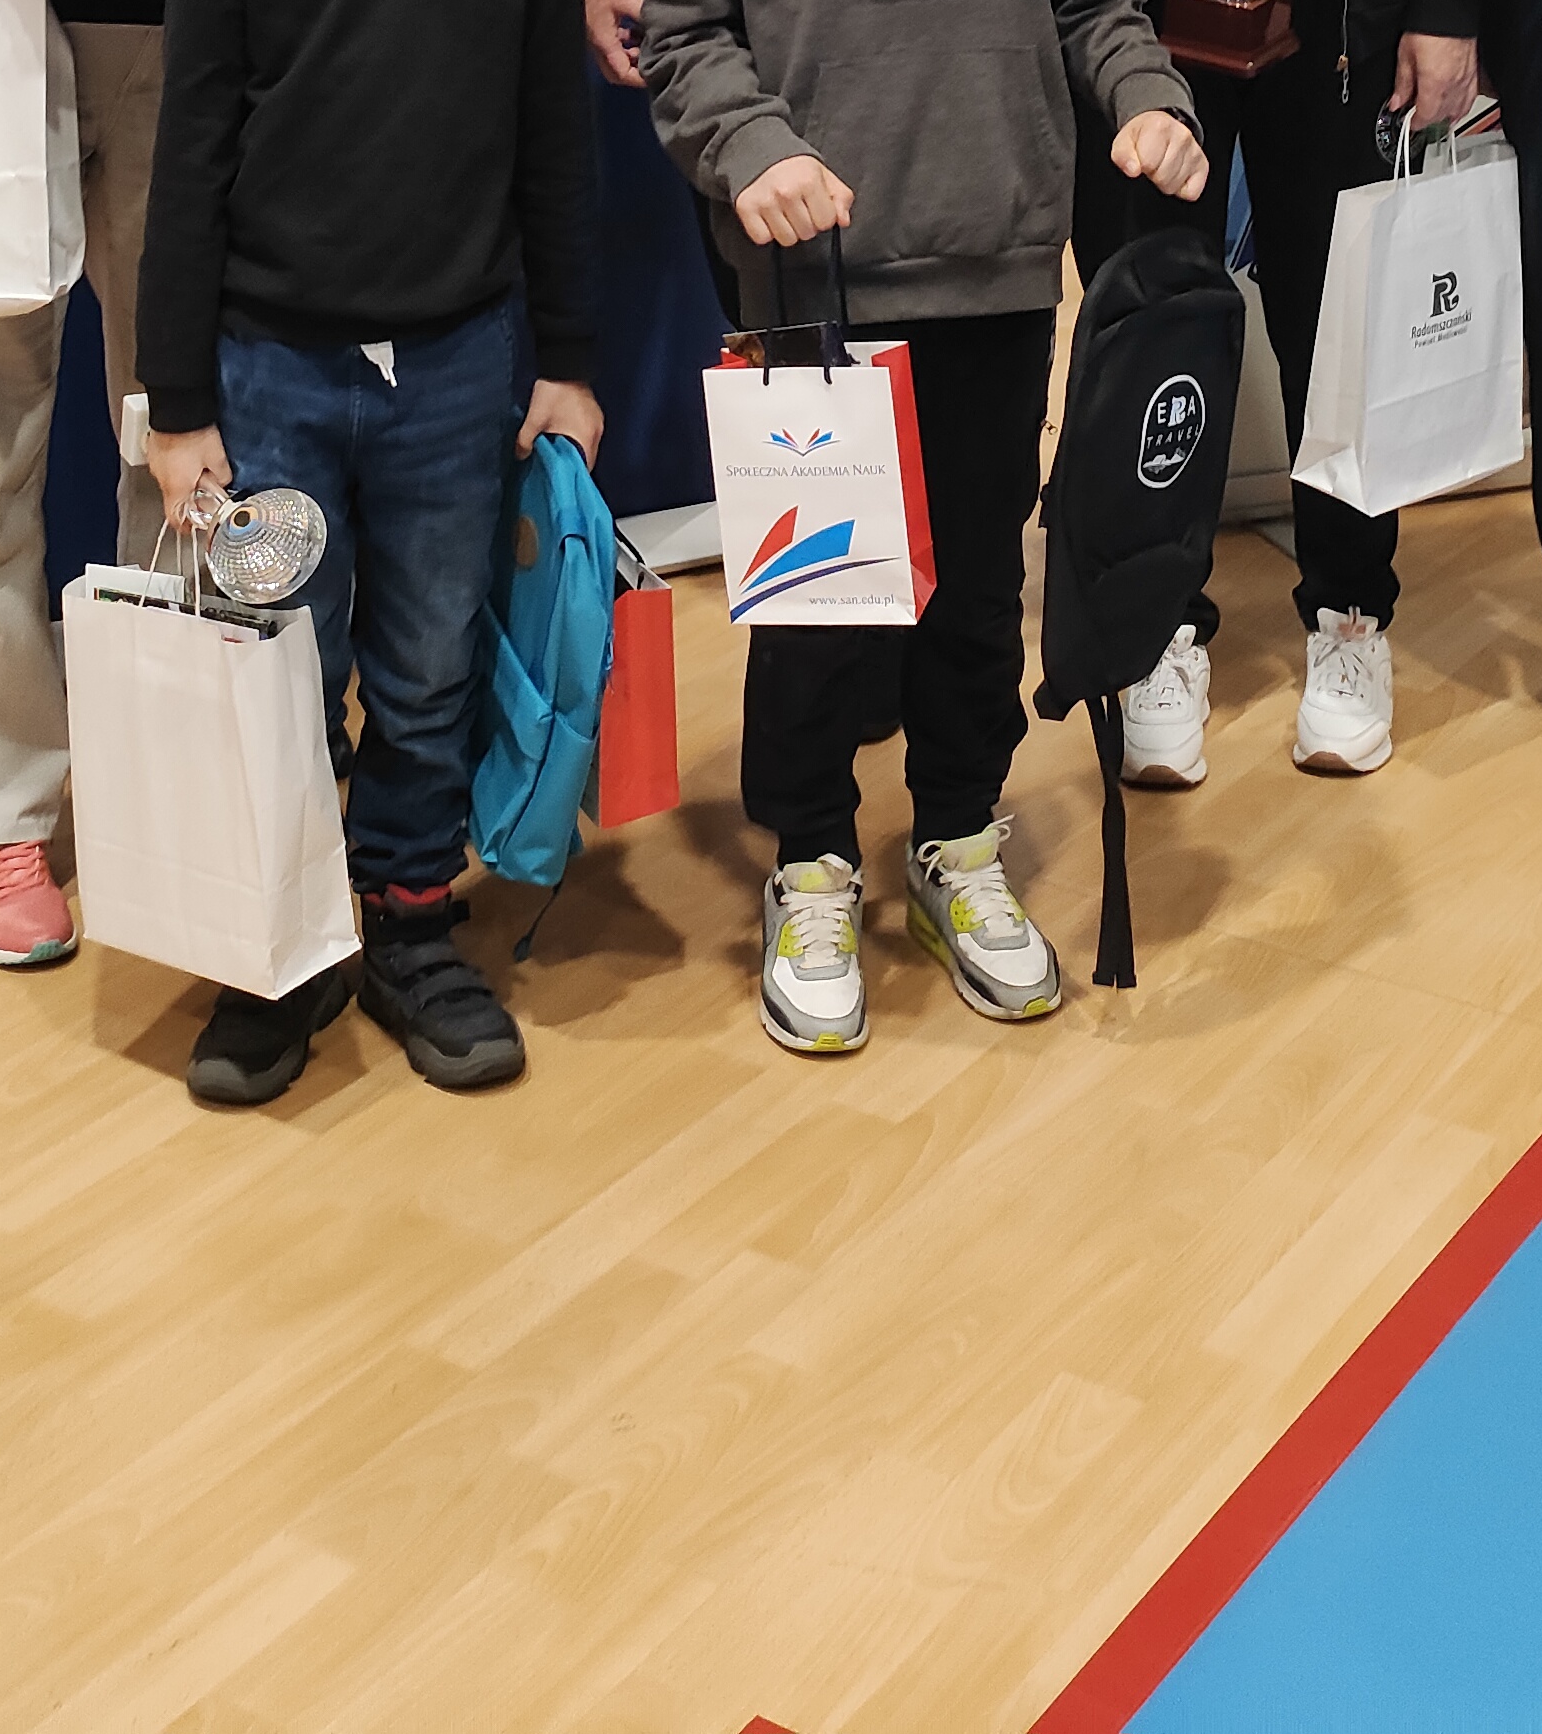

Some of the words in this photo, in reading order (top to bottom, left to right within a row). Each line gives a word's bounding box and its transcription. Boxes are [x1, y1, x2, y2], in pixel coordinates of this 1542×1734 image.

[1146, 423, 1199, 450] TRAVEL
[790, 464, 850, 477] AKADEMIA
[852, 463, 886, 476] NAUK
[809, 593, 895, 607] www.san.edu.pl
